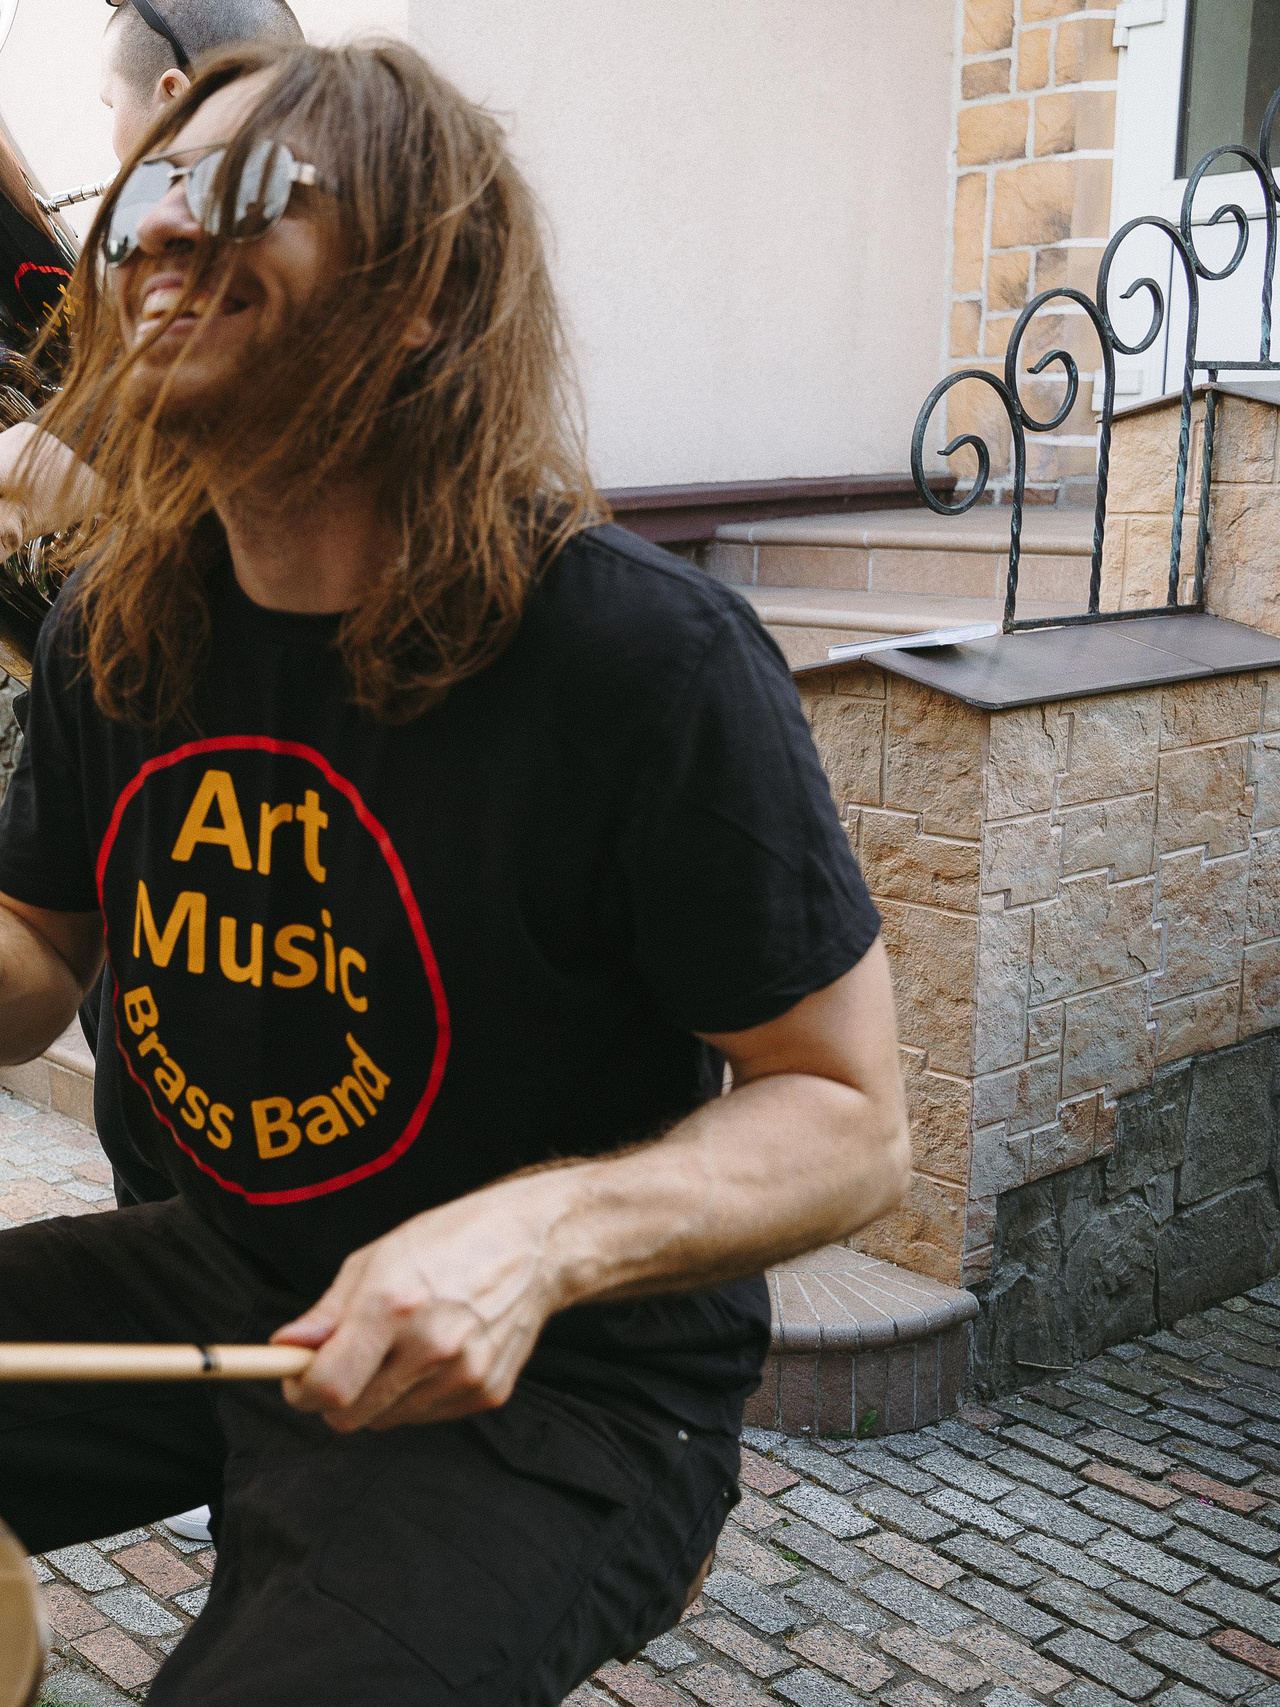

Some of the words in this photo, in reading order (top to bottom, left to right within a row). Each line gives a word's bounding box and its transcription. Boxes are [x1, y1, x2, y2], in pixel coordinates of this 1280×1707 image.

[170, 769, 329, 884] Art
[132, 879, 368, 1013] Music
[123, 985, 235, 1150] Brass
[250, 1031, 391, 1160] Band
